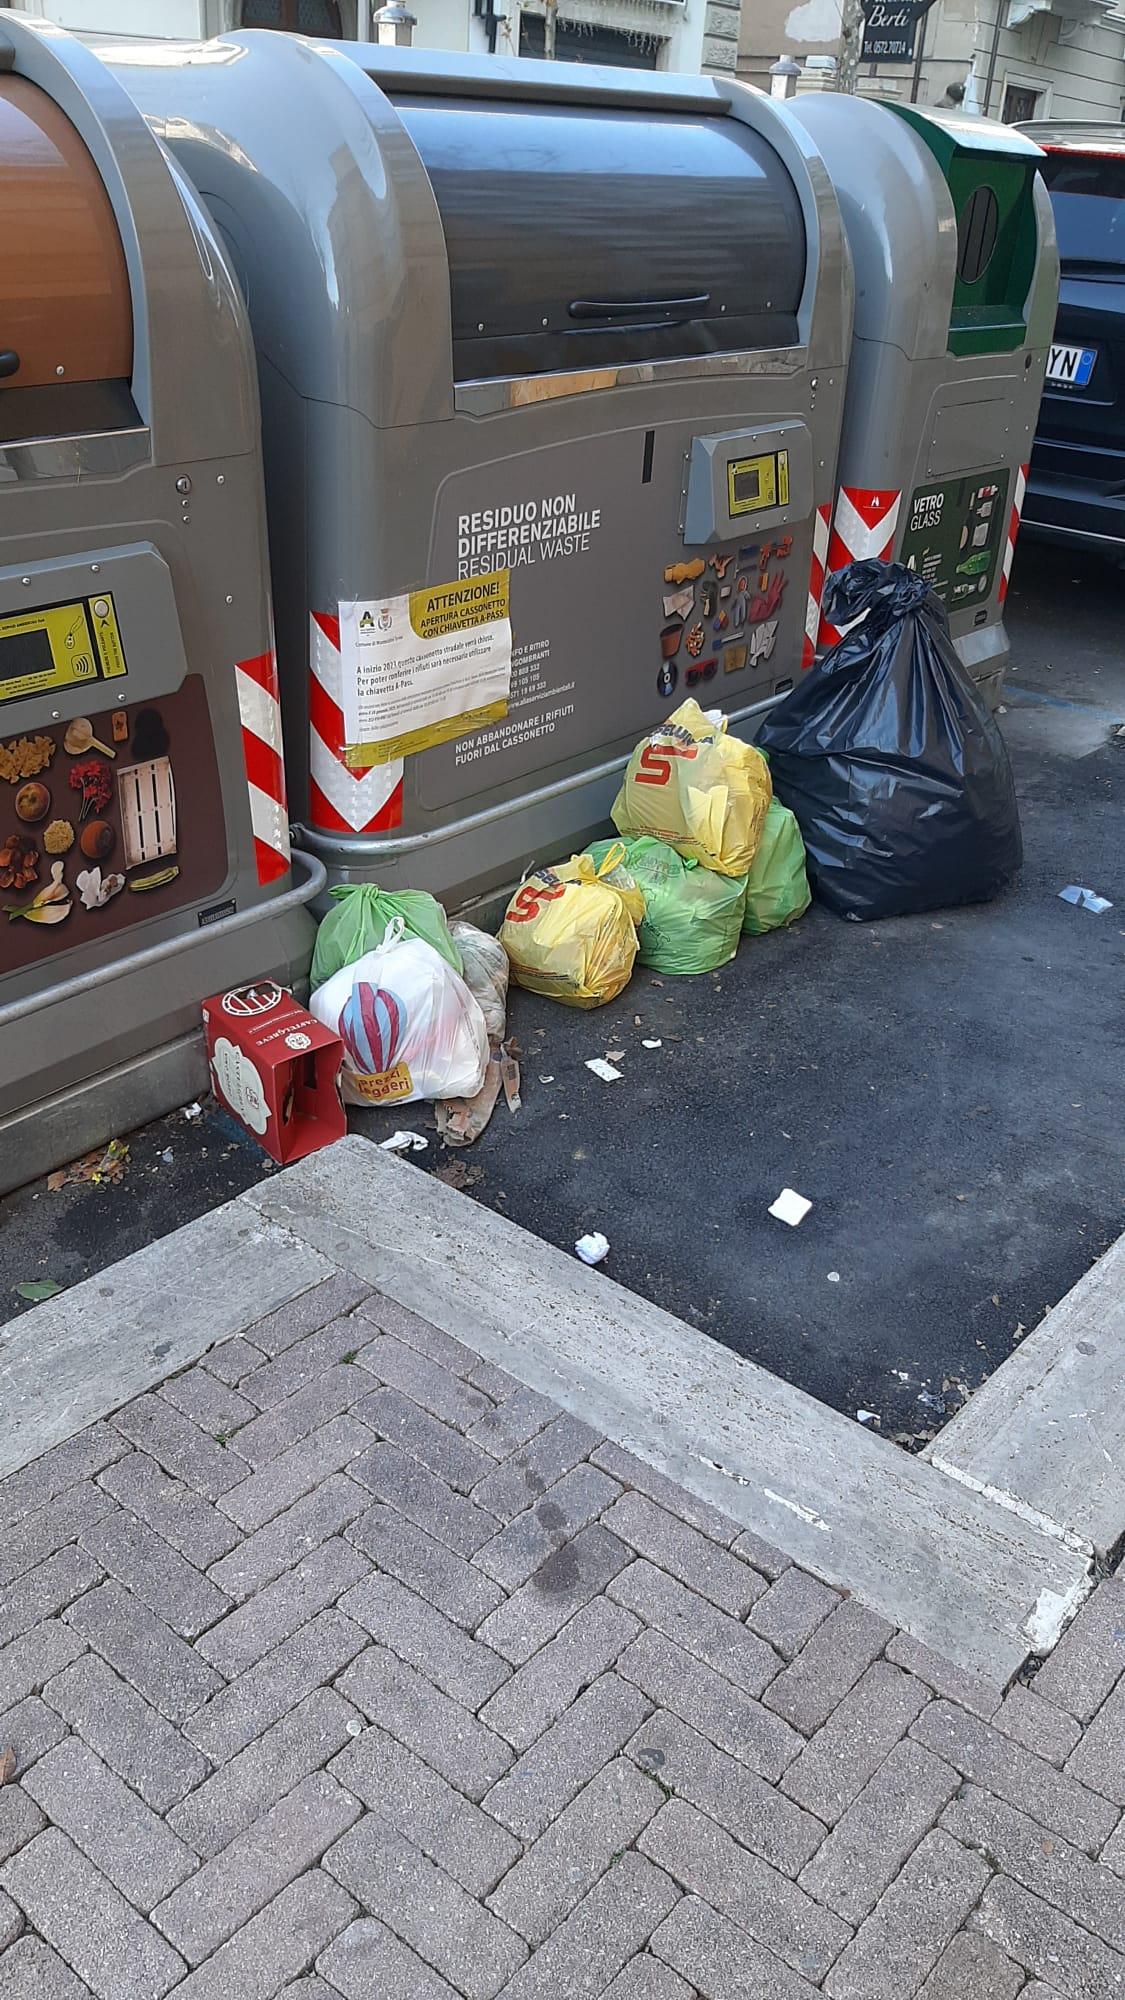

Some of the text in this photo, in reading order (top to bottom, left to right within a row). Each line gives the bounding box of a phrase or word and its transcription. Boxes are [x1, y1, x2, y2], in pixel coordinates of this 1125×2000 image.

[867, 5, 911, 27] Berti
[1049, 347, 1078, 378] YN
[458, 494, 576, 536] RESIDUO NON
[913, 493, 944, 514] VETRO
[458, 509, 601, 558] DIFFERENZIABILE
[910, 510, 942, 532] GLASS
[458, 532, 591, 580] RESIDUAL WASTE
[427, 582, 500, 612] ATTENZIONE!
[420, 599, 506, 628] APERTURA CASSONETTO
[422, 609, 504, 639] CON CHIAVETTA A-PASS
[357, 666, 361, 674] A
[363, 664, 382, 674] inizio
[416, 648, 443, 662] cassonetto
[443, 642, 464, 654] stradale
[524, 645, 529, 653] E
[529, 639, 550, 652] RITIRO
[357, 676, 369, 686] Per
[370, 673, 389, 686] poter
[388, 669, 411, 681] conferire
[415, 662, 431, 672] rifiuti
[431, 659, 442, 668] sarà
[443, 652, 468, 665] necessario
[469, 646, 491, 658] utilizzare
[357, 687, 365, 697] la
[366, 682, 395, 697] chiavetta
[455, 704, 574, 754] NON ABBANDONARE I RIFIUTI
[455, 722, 555, 766] FUORI DAL CASSONETTO
